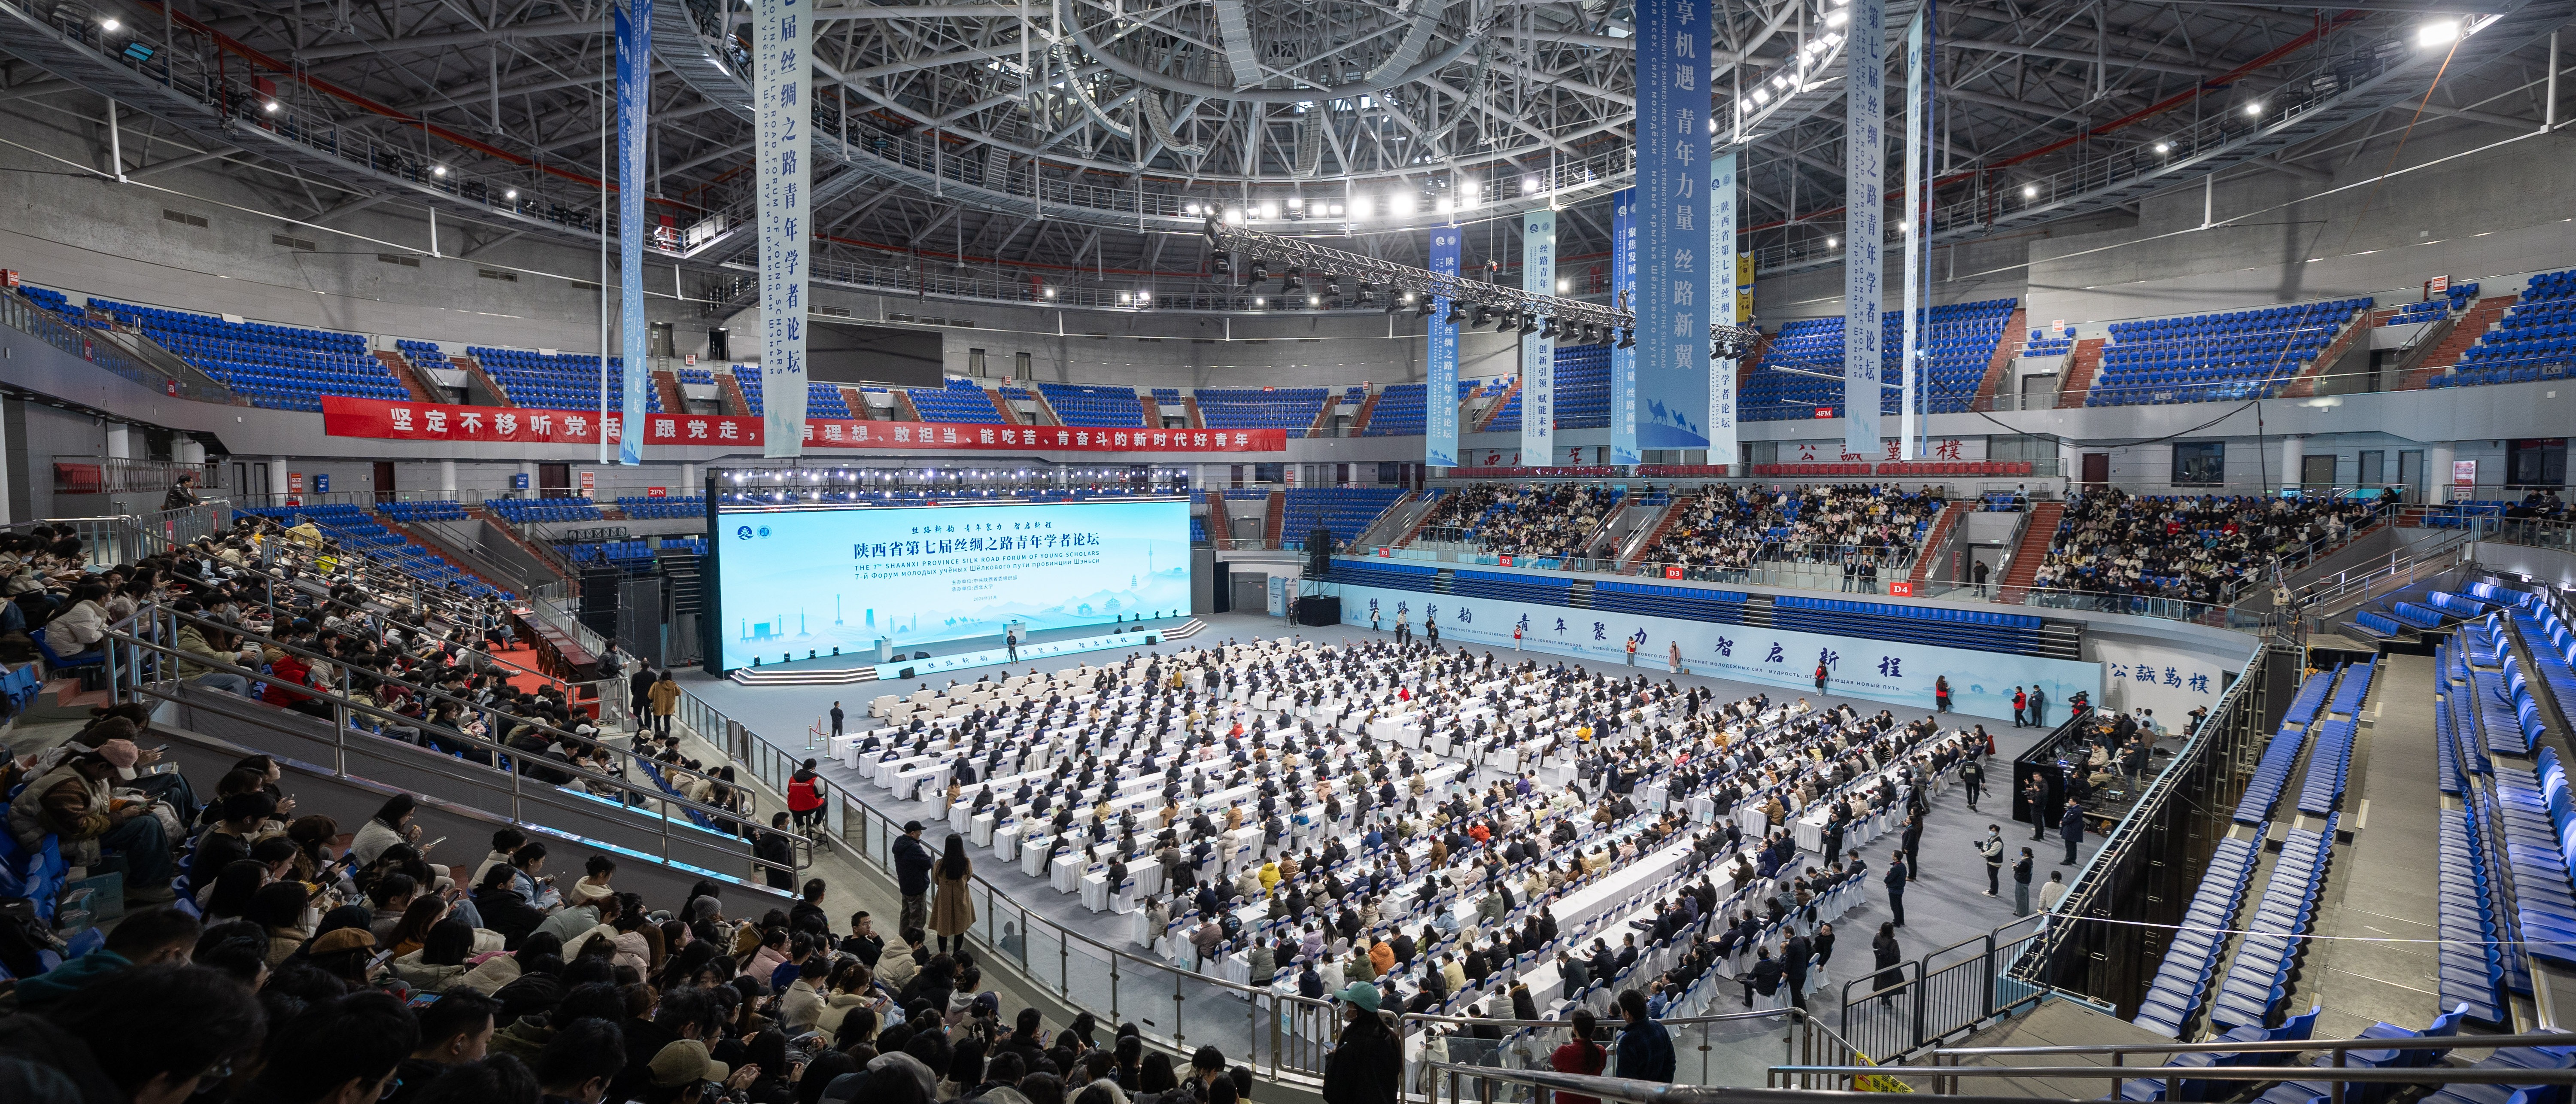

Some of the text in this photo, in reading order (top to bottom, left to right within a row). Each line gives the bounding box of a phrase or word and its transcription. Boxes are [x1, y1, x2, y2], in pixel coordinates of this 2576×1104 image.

[1674, 108, 1695, 231] 青年力量
[781, 0, 800, 375] 届丝绸之路青年学者论坛
[773, 216, 779, 232] OF
[1649, 214, 1658, 259] крылья
[1860, 236, 1865, 251] OF
[1540, 244, 1548, 288] 丝路青年
[1661, 304, 1666, 314] OF
[1674, 248, 1694, 370] 丝路新翼
[1538, 344, 1547, 388] 创新引领
[1538, 394, 1546, 437] 赋能未来
[911, 521, 1052, 534] 丝路新韵 青年聚力 智启新程
[854, 532, 1100, 560] 陕西省第七届丝绸之路青年学者论坛
[871, 572, 898, 580] Форум
[939, 566, 967, 575] учёных
[922, 558, 959, 566] PROVINCE
[1710, 662, 1750, 670] МОЛОДЁЖНЫХ
